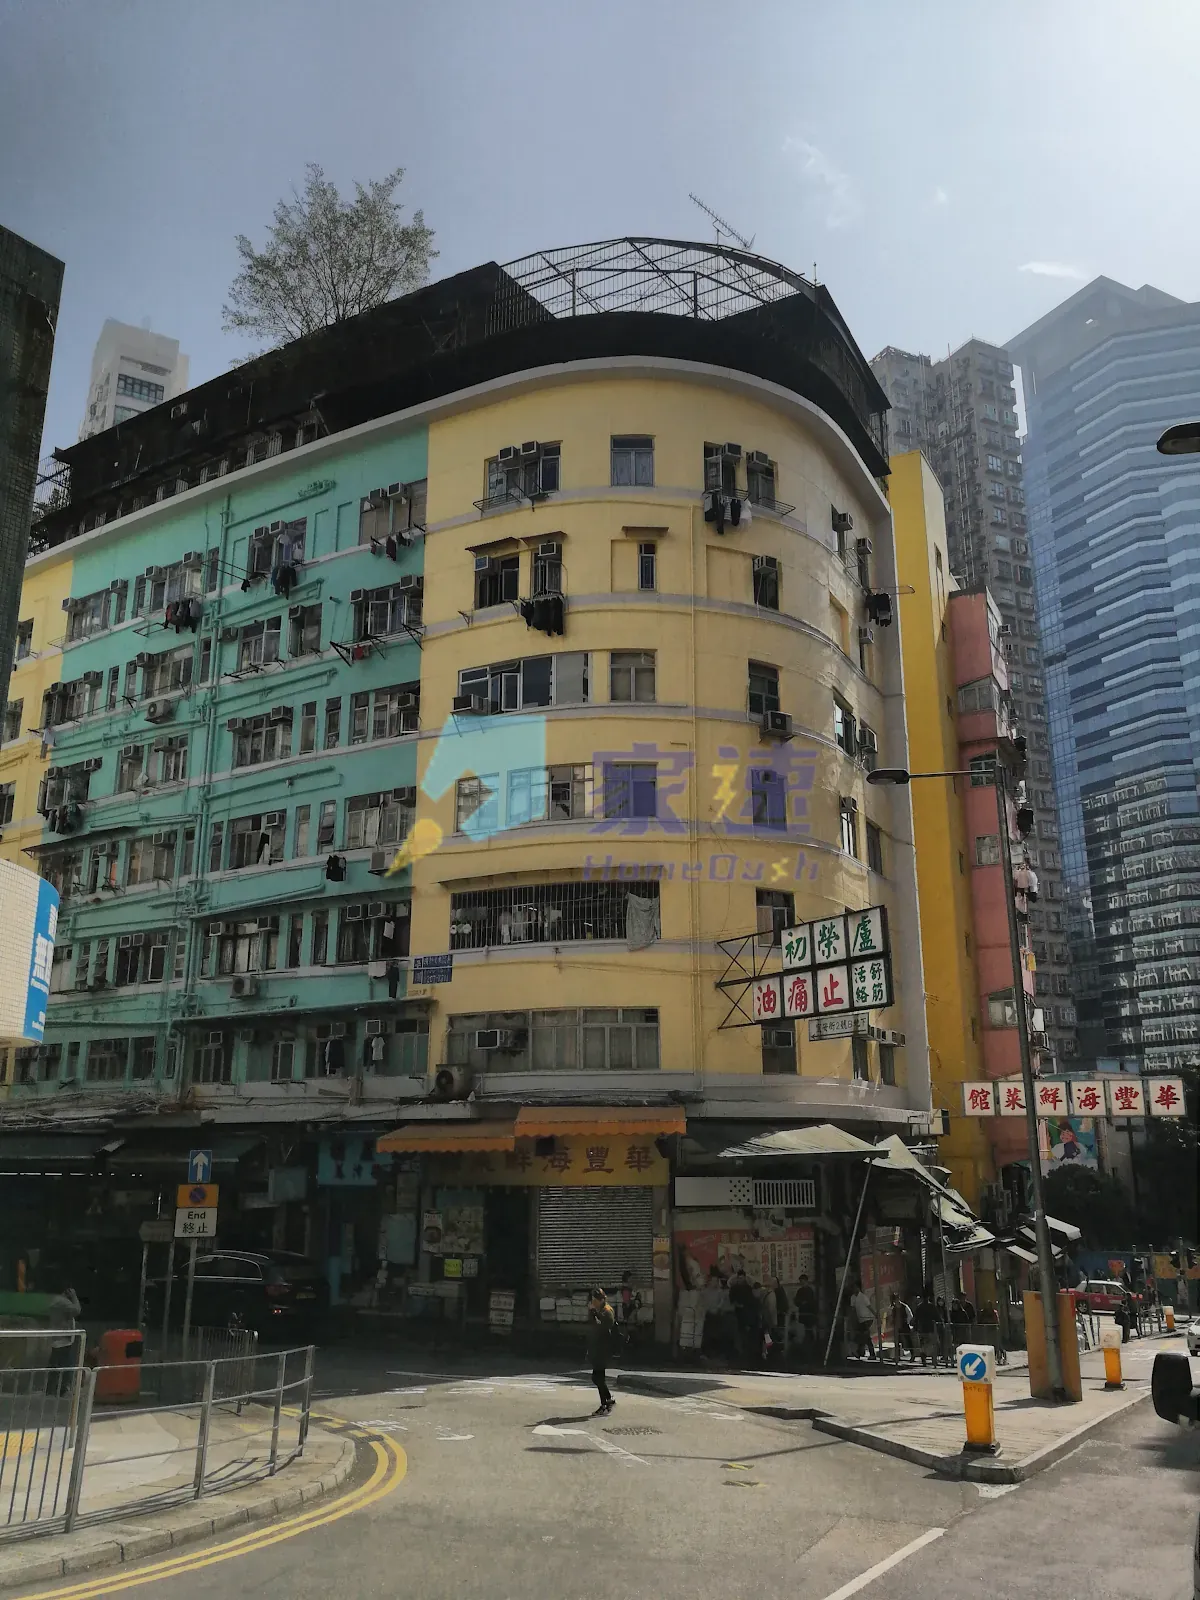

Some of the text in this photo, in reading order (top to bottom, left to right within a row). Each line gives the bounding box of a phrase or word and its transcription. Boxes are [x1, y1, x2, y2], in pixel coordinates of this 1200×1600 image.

[756, 973, 844, 1016] 止痛油
[968, 1085, 1181, 1111] 華豐海鮮菜館
[187, 1211, 206, 1220] End
[182, 1222, 208, 1234] 終止
